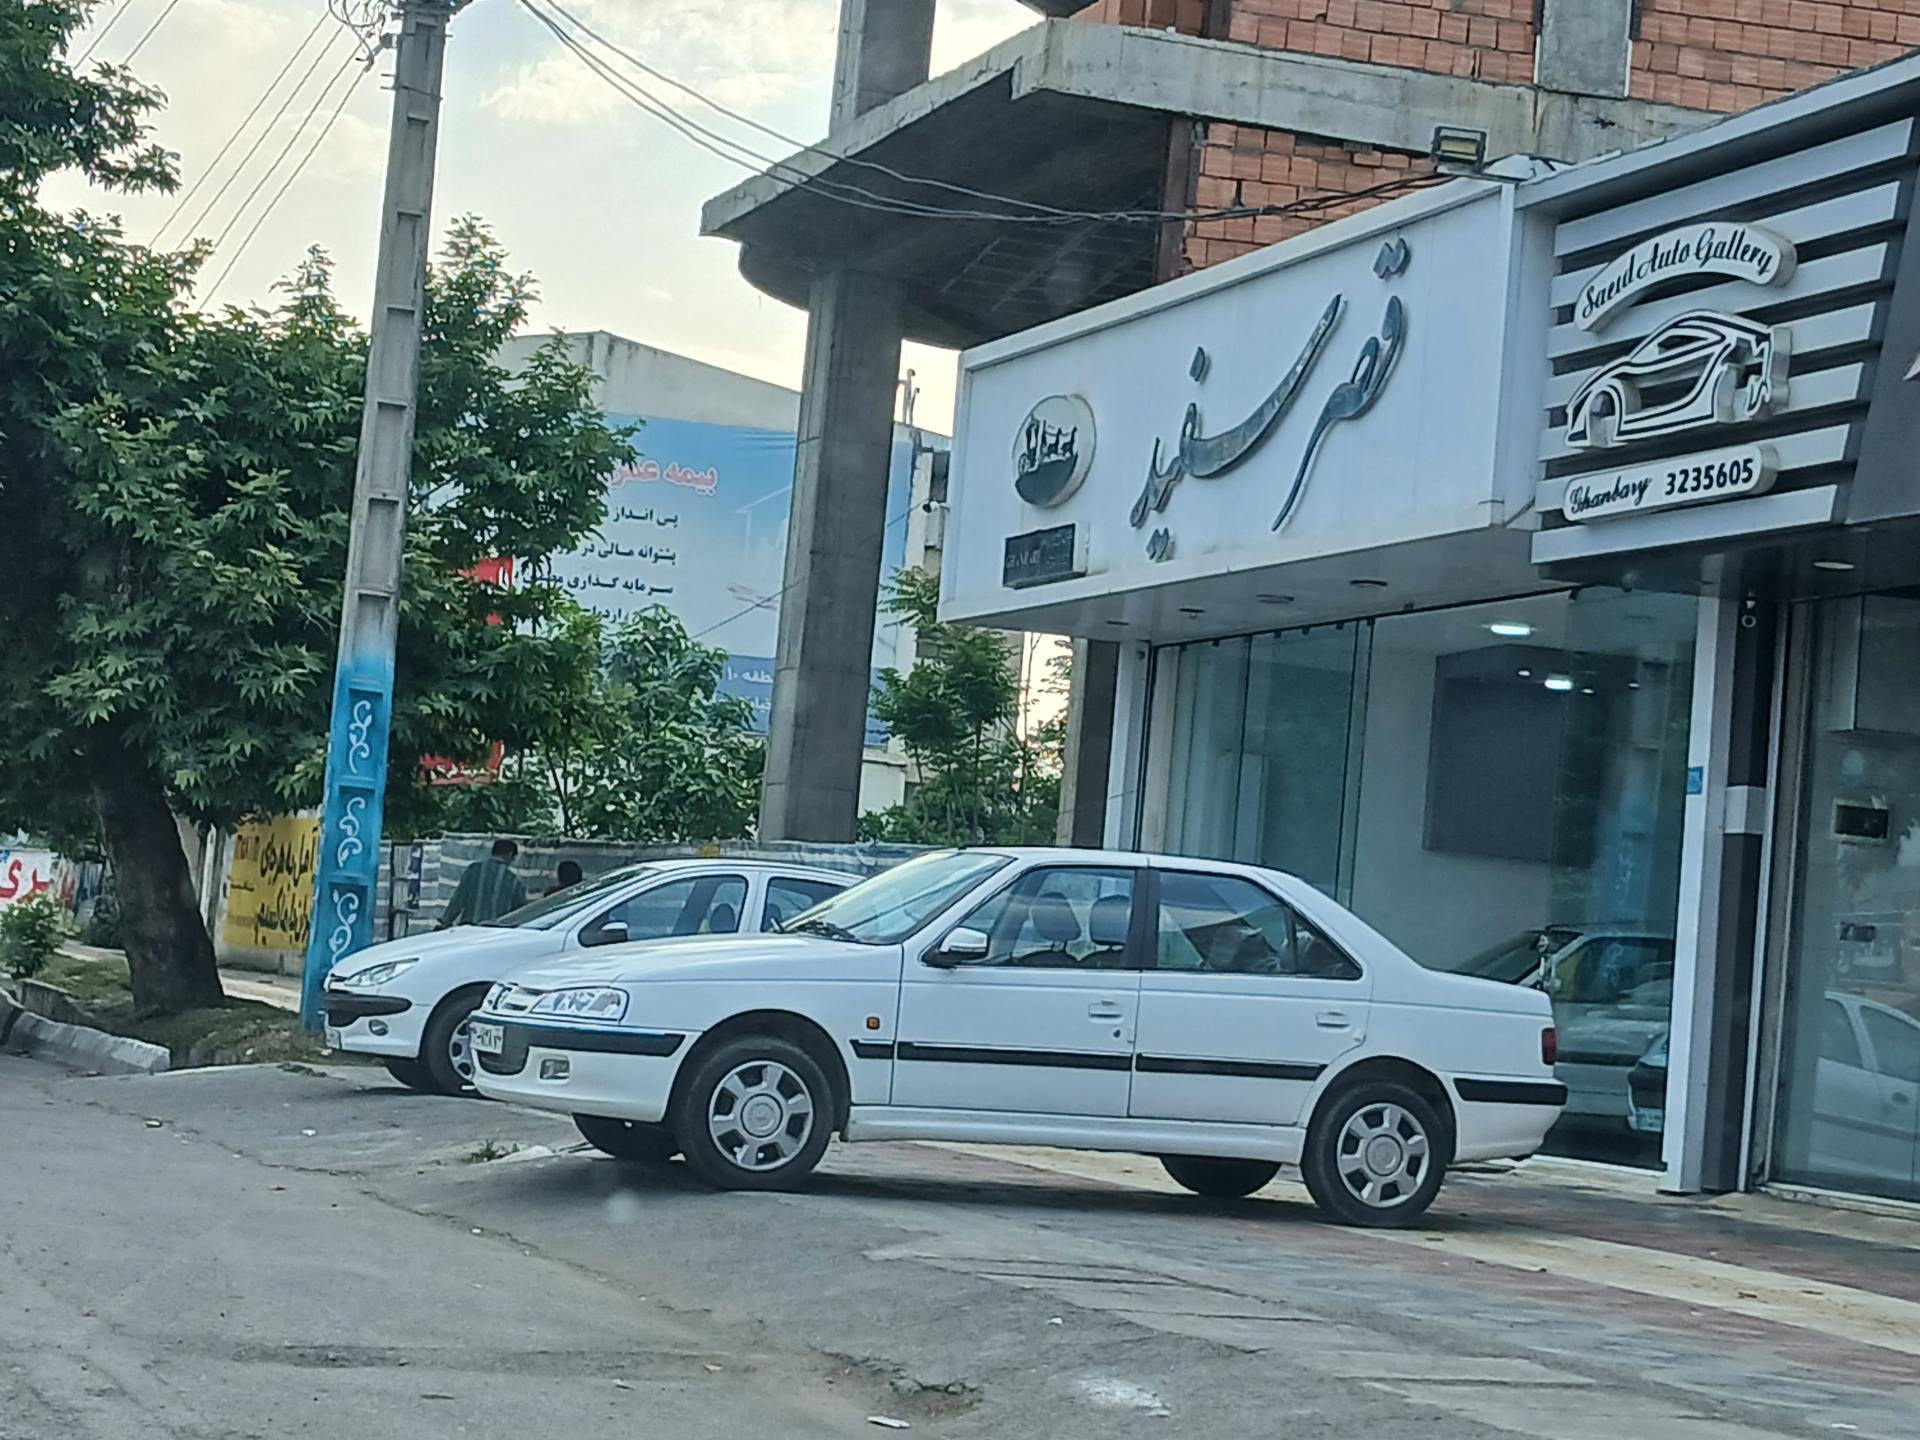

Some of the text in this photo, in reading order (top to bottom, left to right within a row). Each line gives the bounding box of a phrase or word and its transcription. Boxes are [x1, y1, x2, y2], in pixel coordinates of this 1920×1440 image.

[1636, 239, 1690, 280] Auto
[1696, 228, 1773, 276] Gallery
[664, 463, 717, 495] بیمه
[1665, 458, 1754, 496] 3235605
[598, 543, 633, 559] مالی
